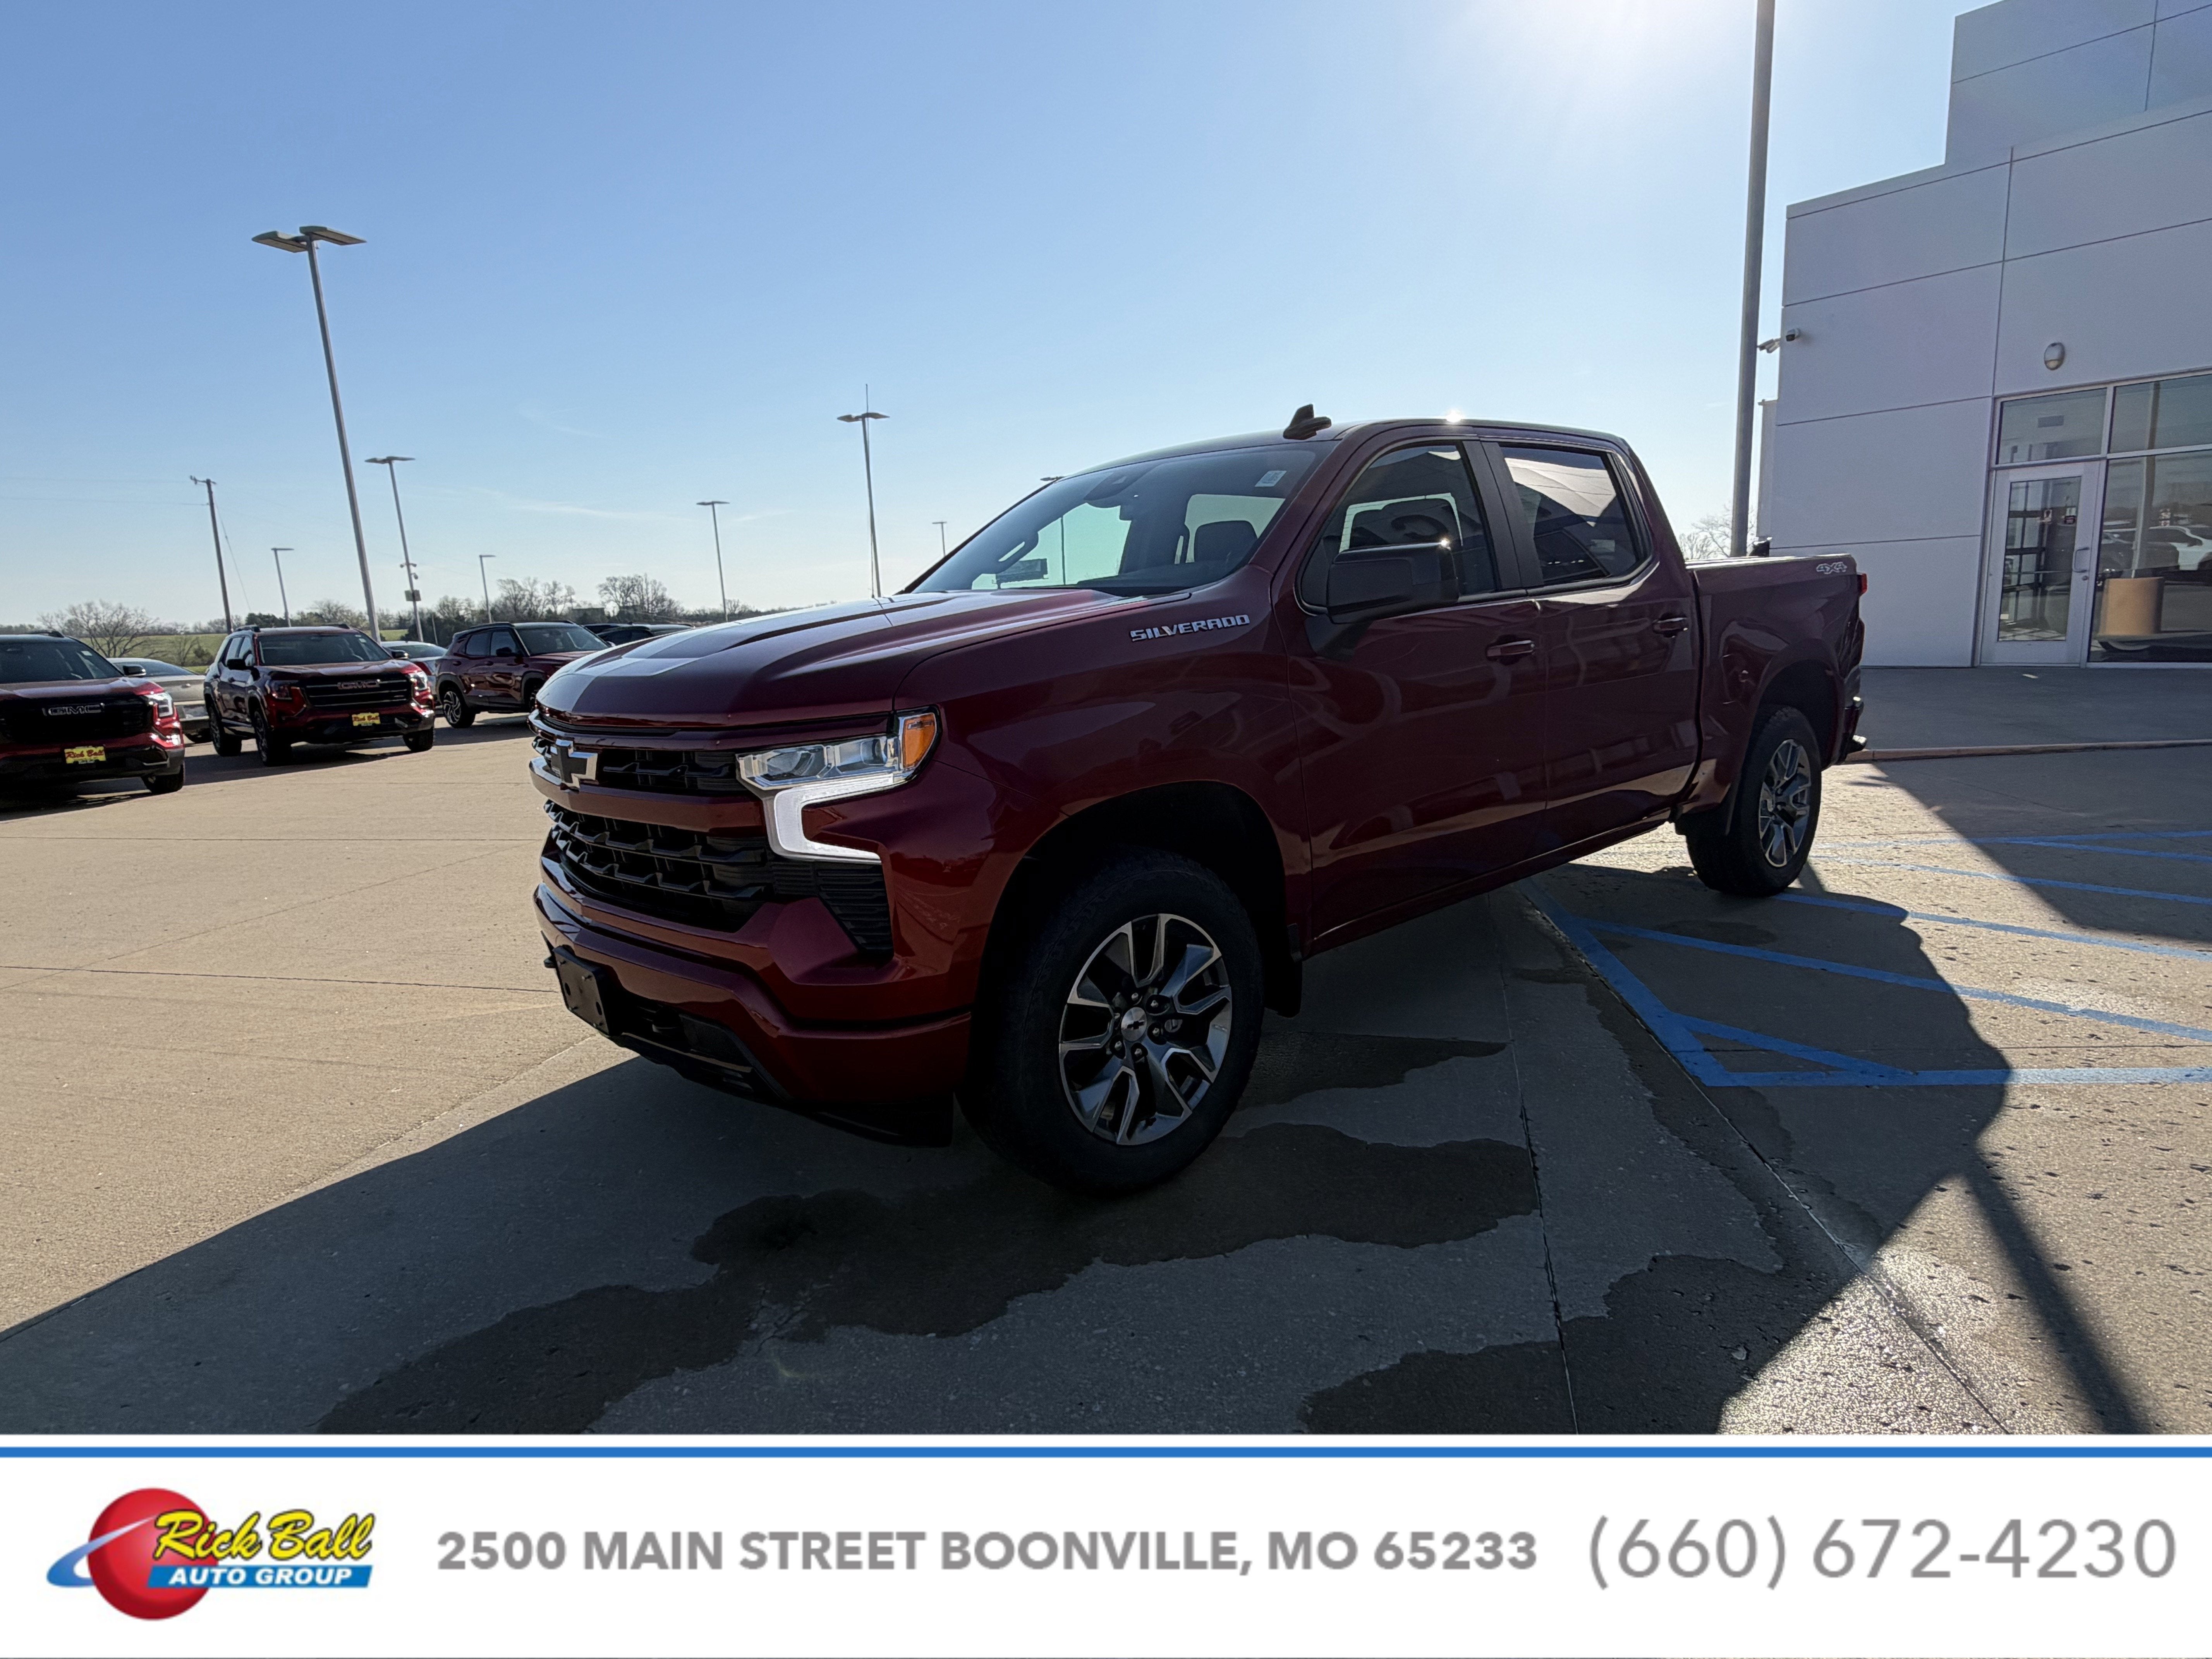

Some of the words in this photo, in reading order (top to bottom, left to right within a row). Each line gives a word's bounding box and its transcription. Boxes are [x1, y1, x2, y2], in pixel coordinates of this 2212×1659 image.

[1130, 614, 1250, 642] SILVERADO
[337, 680, 380, 689] GMC
[46, 703, 105, 716] GMC
